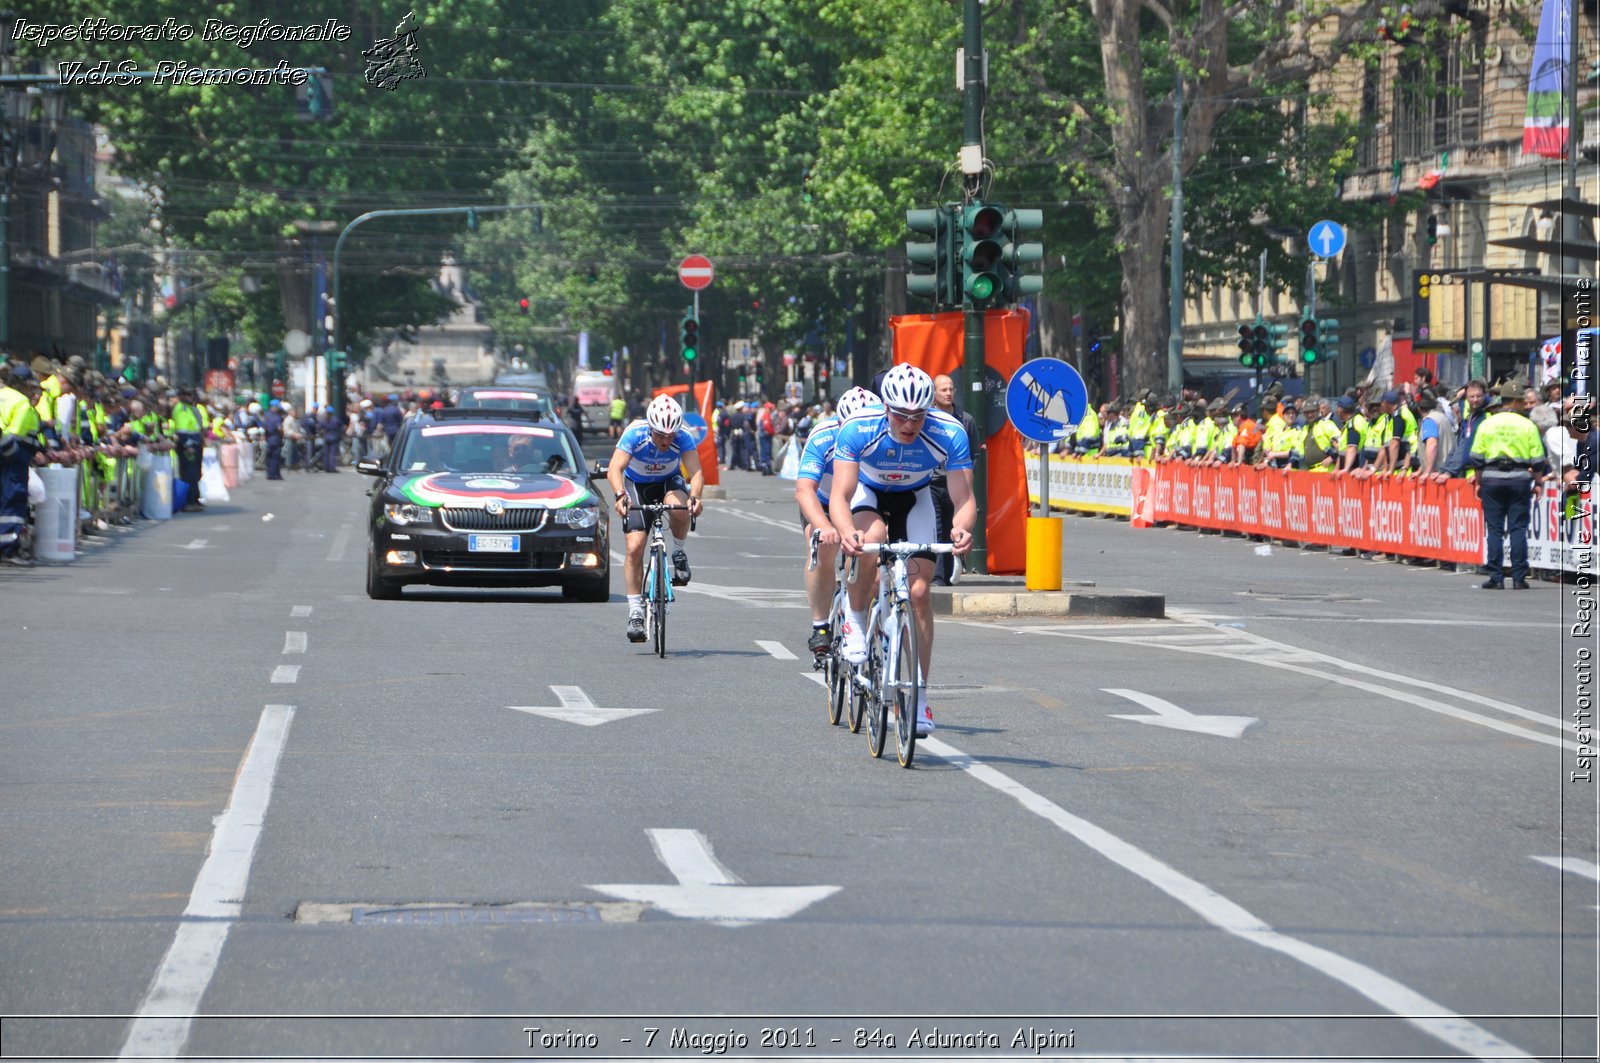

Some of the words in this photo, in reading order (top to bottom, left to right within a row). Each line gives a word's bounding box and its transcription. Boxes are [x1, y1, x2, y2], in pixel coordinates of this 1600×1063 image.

[1338, 481, 1363, 539] Adecco
[1369, 483, 1404, 544] Adecco
[1409, 486, 1441, 548] Adecco
[1447, 489, 1479, 553] Adecco
